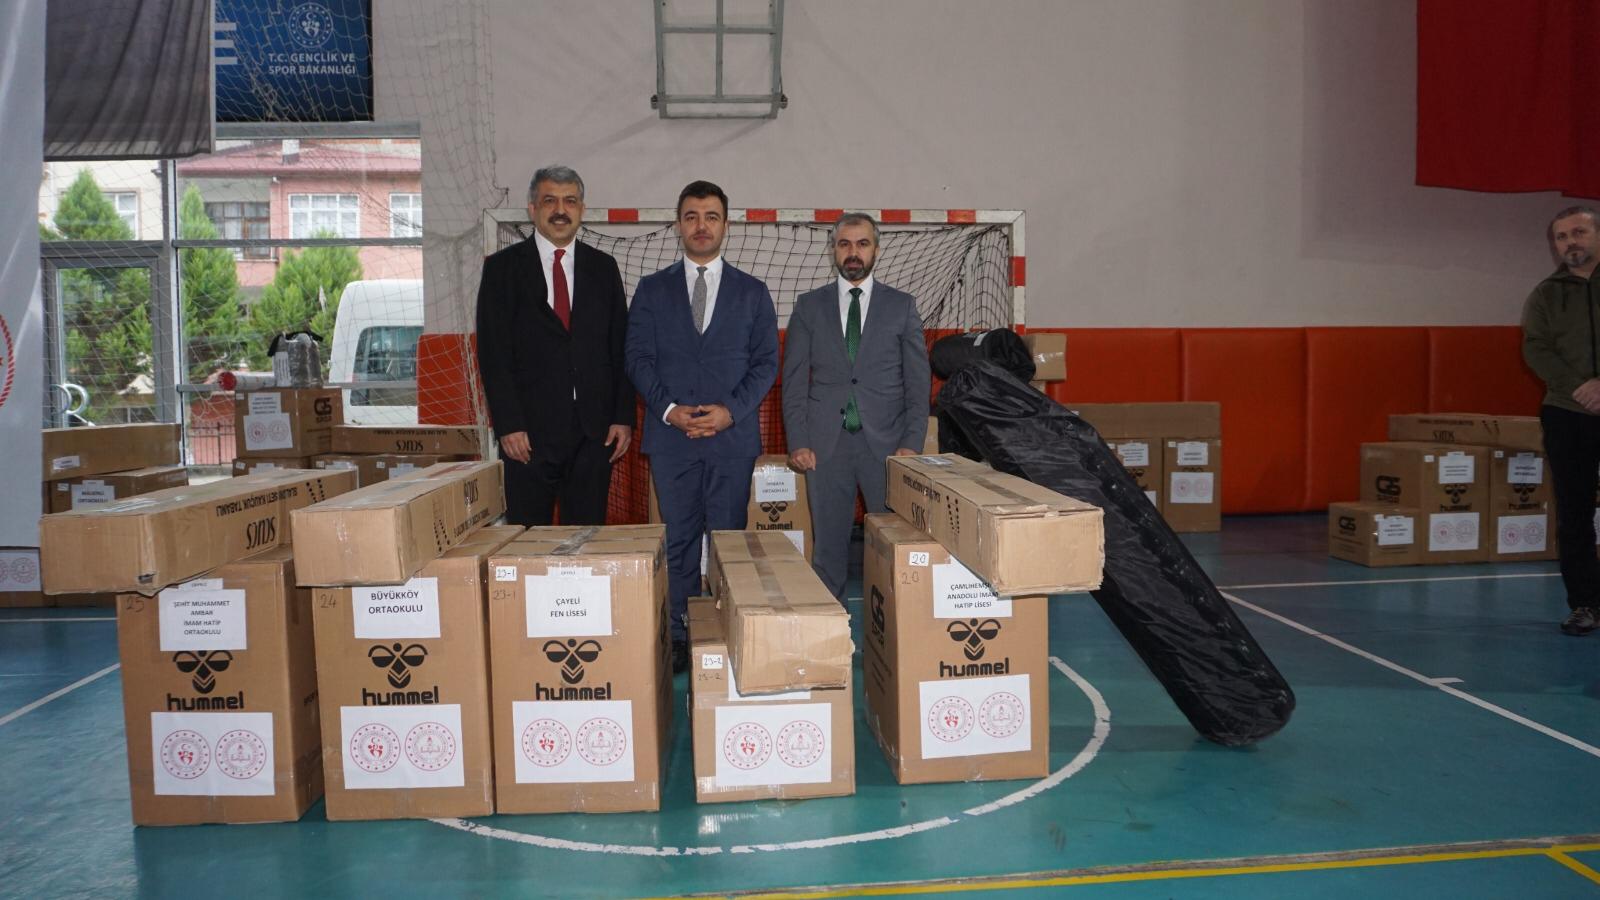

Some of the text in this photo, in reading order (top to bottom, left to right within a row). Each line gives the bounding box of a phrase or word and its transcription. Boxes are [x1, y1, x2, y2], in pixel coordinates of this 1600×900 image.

[268, 51, 356, 63] T.C. GENÇLİK VE
[268, 63, 356, 75] SPOR BAKANLIĞI
[756, 520, 793, 531] hummel
[911, 553, 927, 565] 20
[950, 582, 993, 591] ÇAMLIHEMŞİ
[320, 593, 338, 609] 24
[371, 590, 420, 601] BÜYÜKKÖY
[555, 596, 581, 607] ÇAYELİ
[368, 604, 423, 615] ORTAOKULU
[550, 608, 587, 618] FEN LİSESİ
[939, 656, 1010, 678] hummel
[362, 685, 440, 706] hummel
[536, 681, 612, 701] hummel
[166, 690, 244, 711] hummel
